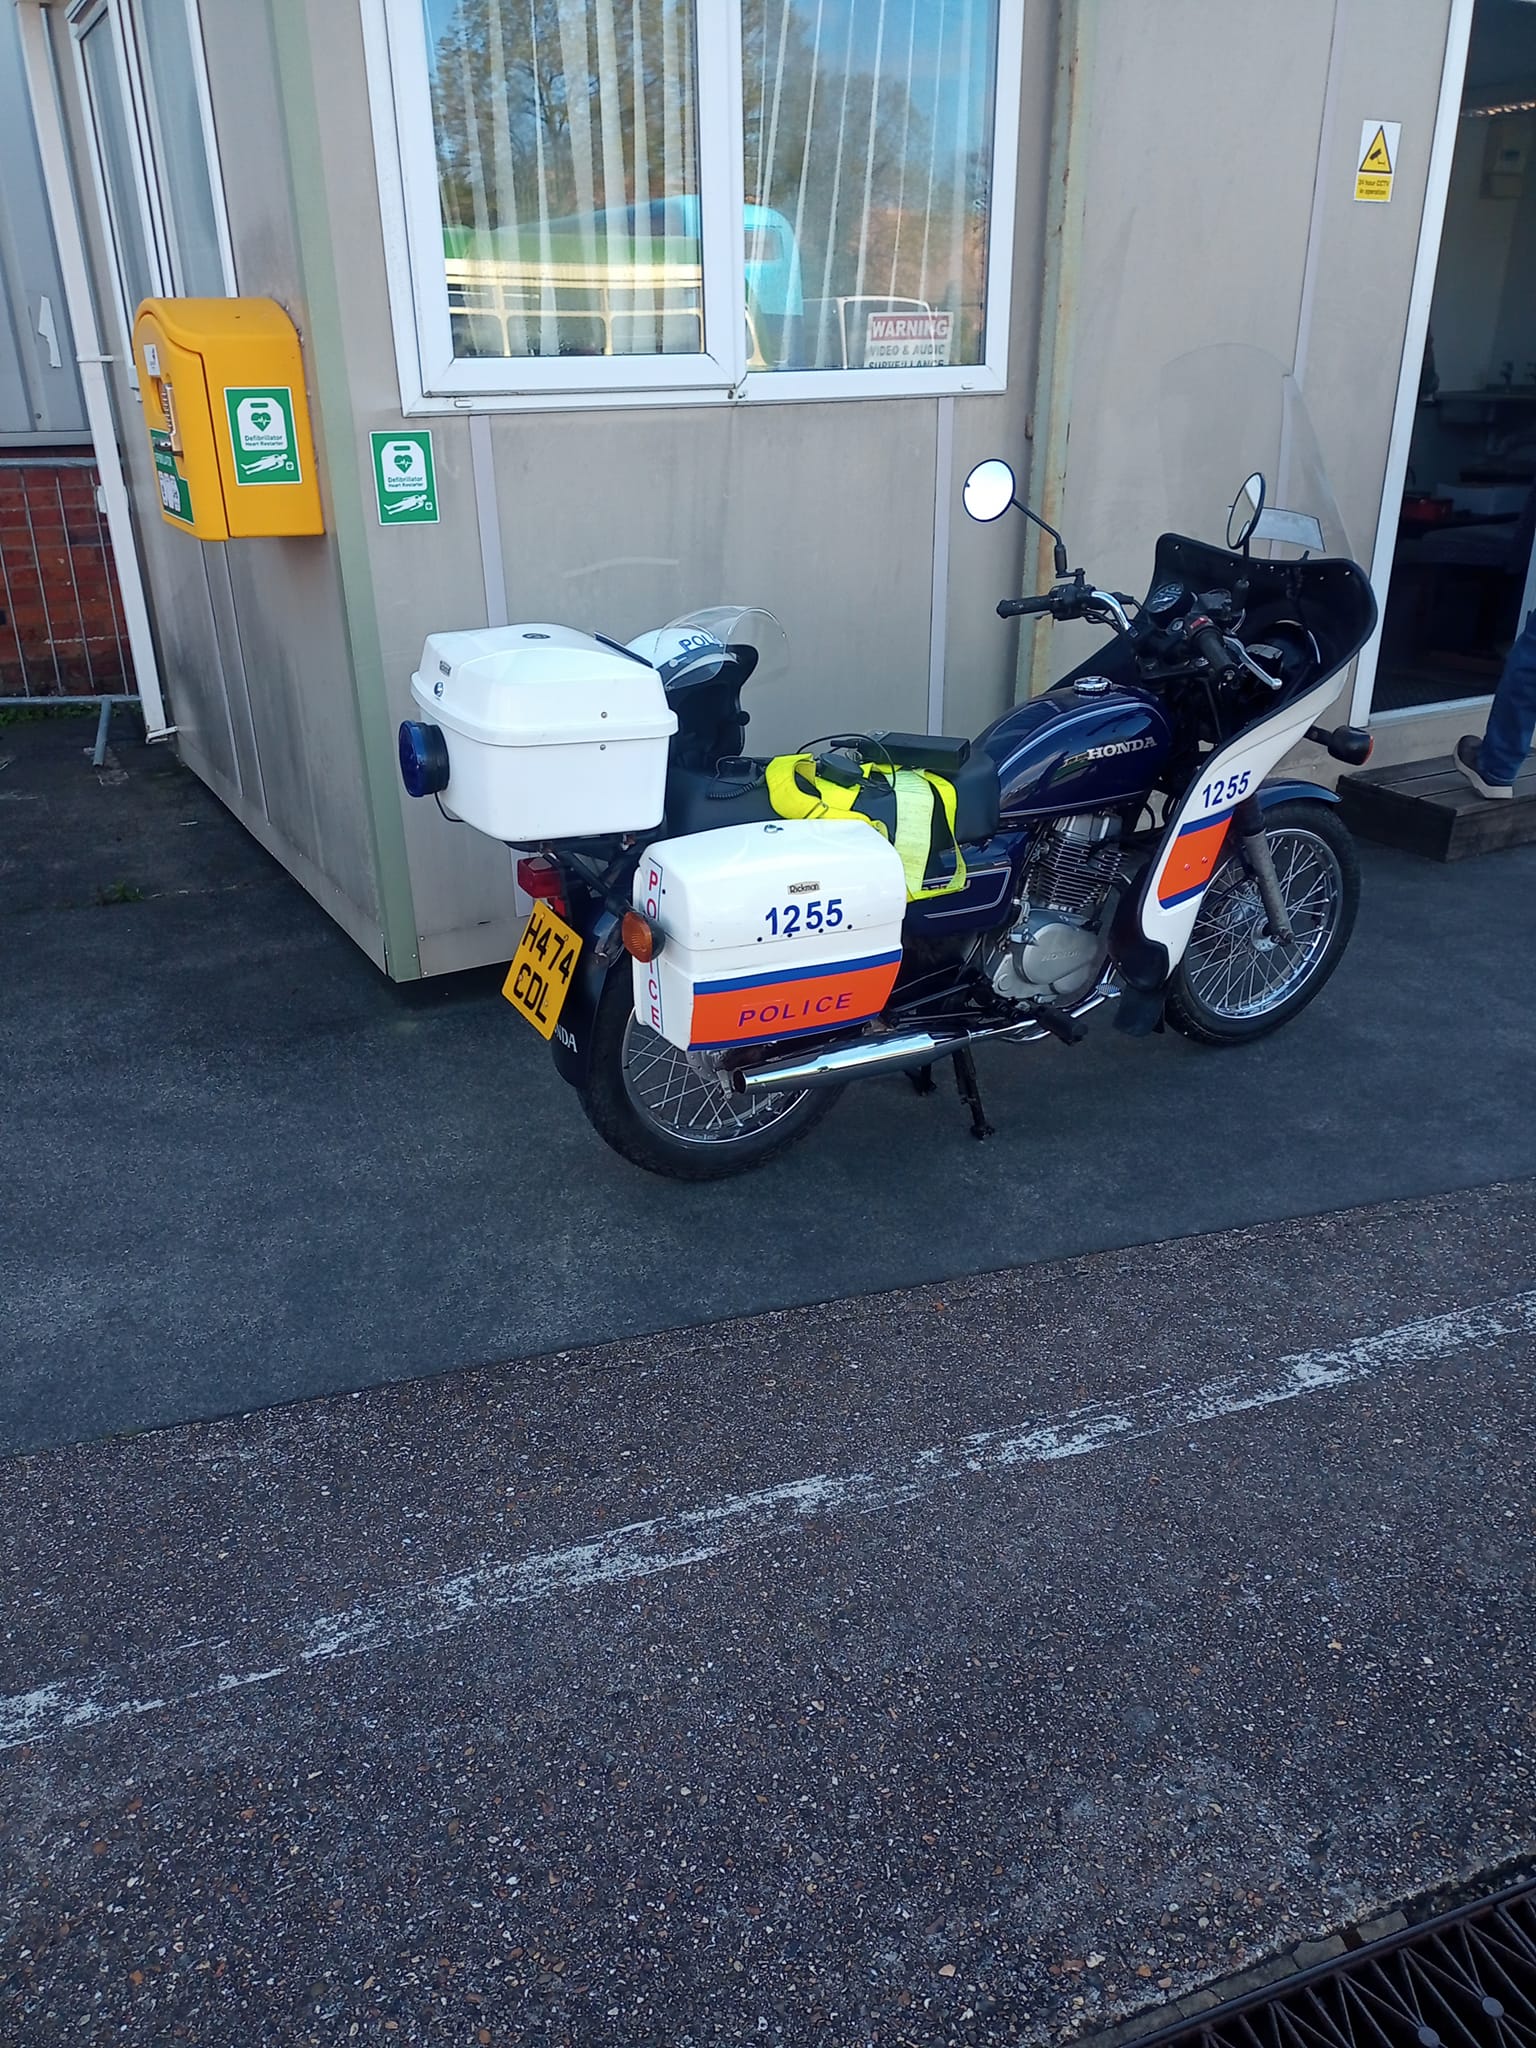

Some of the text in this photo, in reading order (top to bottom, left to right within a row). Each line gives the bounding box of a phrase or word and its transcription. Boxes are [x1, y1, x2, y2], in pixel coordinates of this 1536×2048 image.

[872, 320, 947, 338] WARNING
[871, 345, 899, 356] VIDEO
[902, 345, 909, 355] &
[679, 634, 711, 651] POL
[1087, 736, 1158, 760] HONDA
[1202, 771, 1251, 808] 1255
[789, 883, 819, 894] Rickman
[765, 899, 843, 935] 1255
[522, 912, 574, 984] H474
[647, 870, 660, 1029] POICE
[514, 962, 548, 1024] CDL
[738, 992, 853, 1027] POLICE
[555, 1024, 578, 1053] NDA
